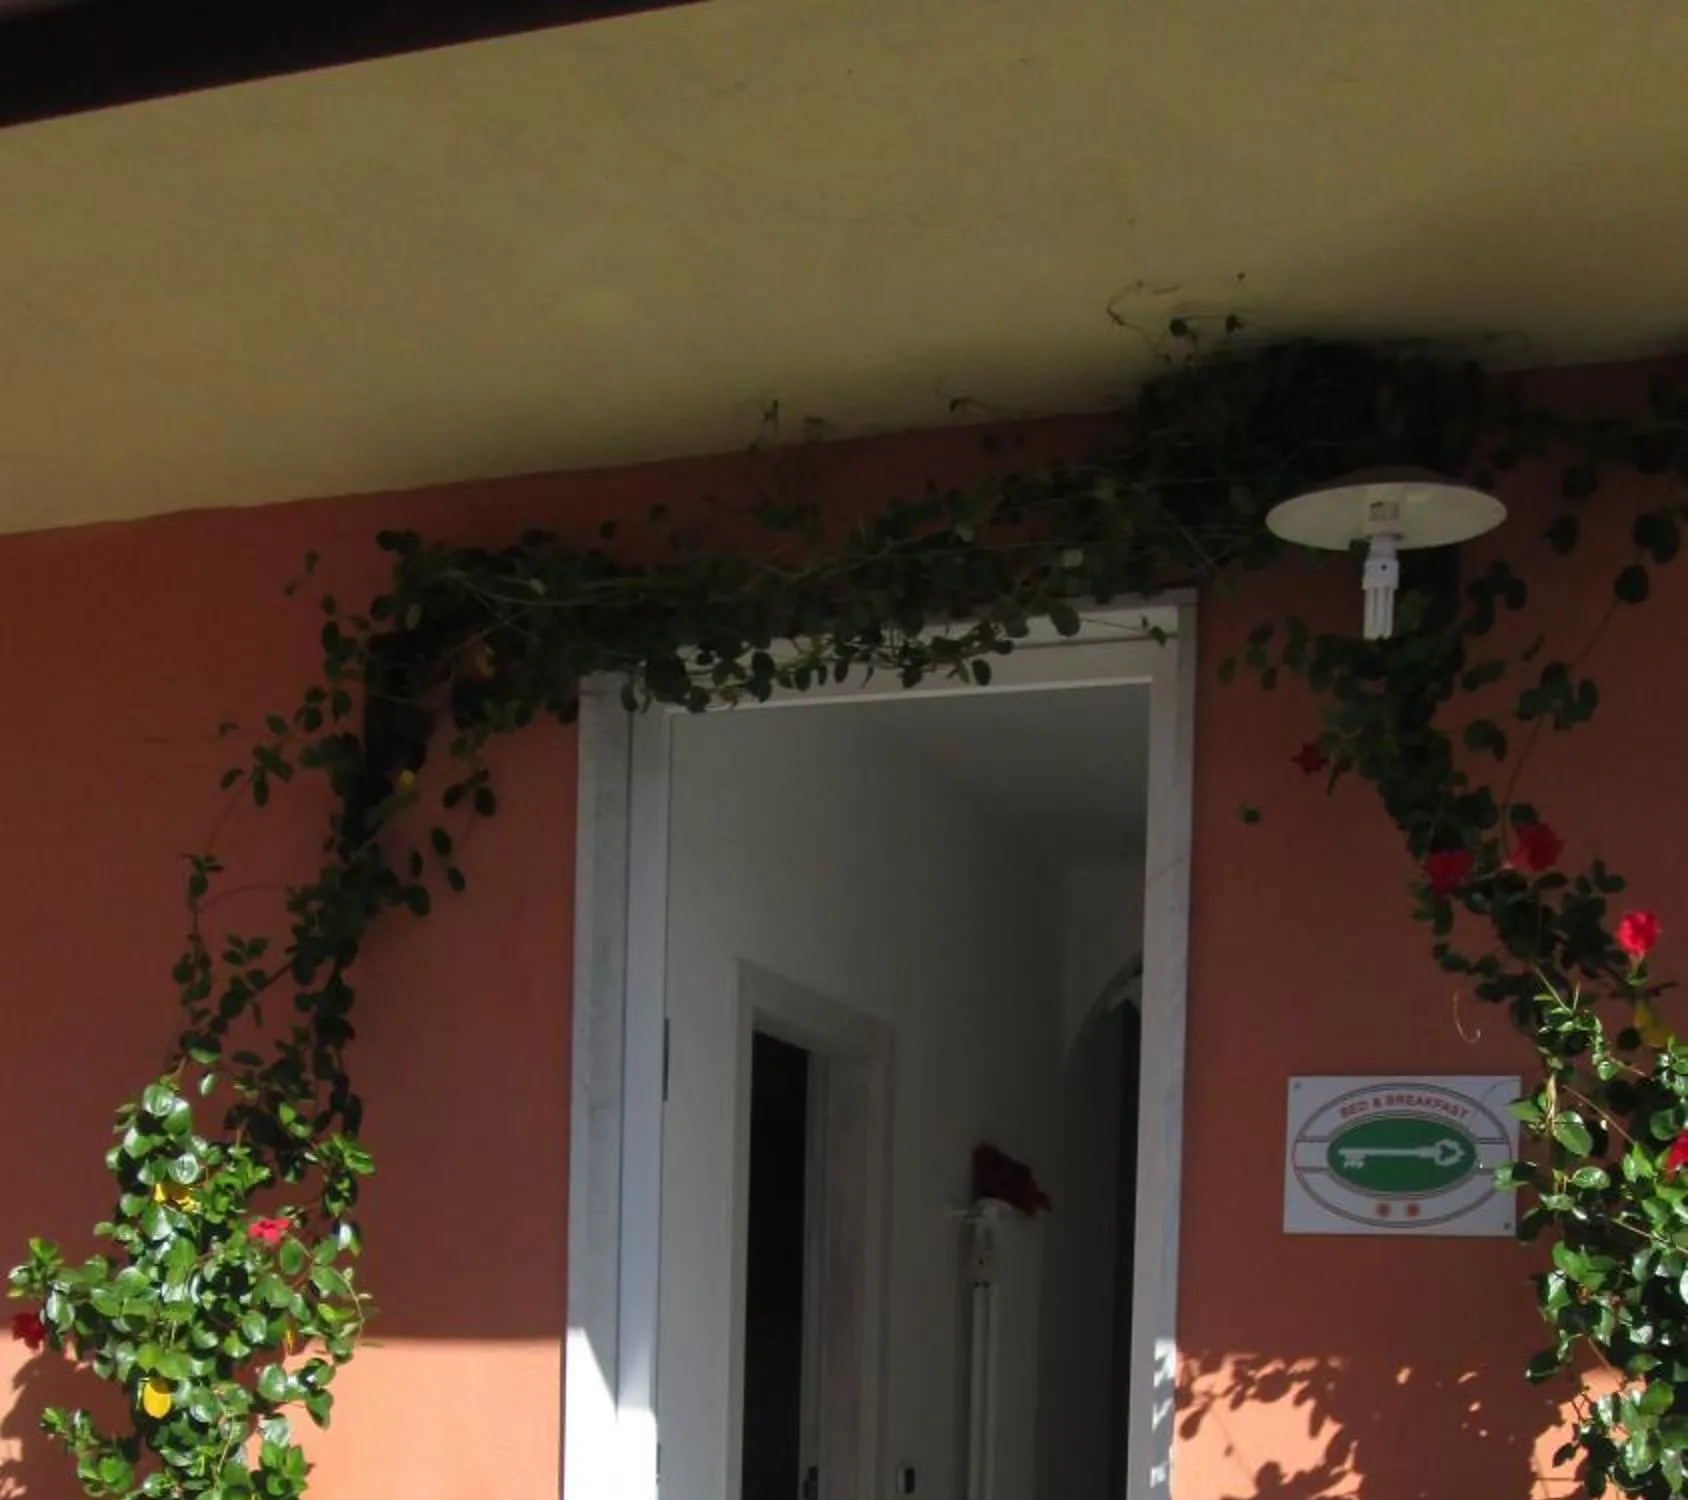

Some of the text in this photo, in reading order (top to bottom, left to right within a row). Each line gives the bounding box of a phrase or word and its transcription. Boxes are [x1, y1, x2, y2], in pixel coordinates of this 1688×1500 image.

[1340, 1094, 1469, 1118] BED & BREAKFAST
